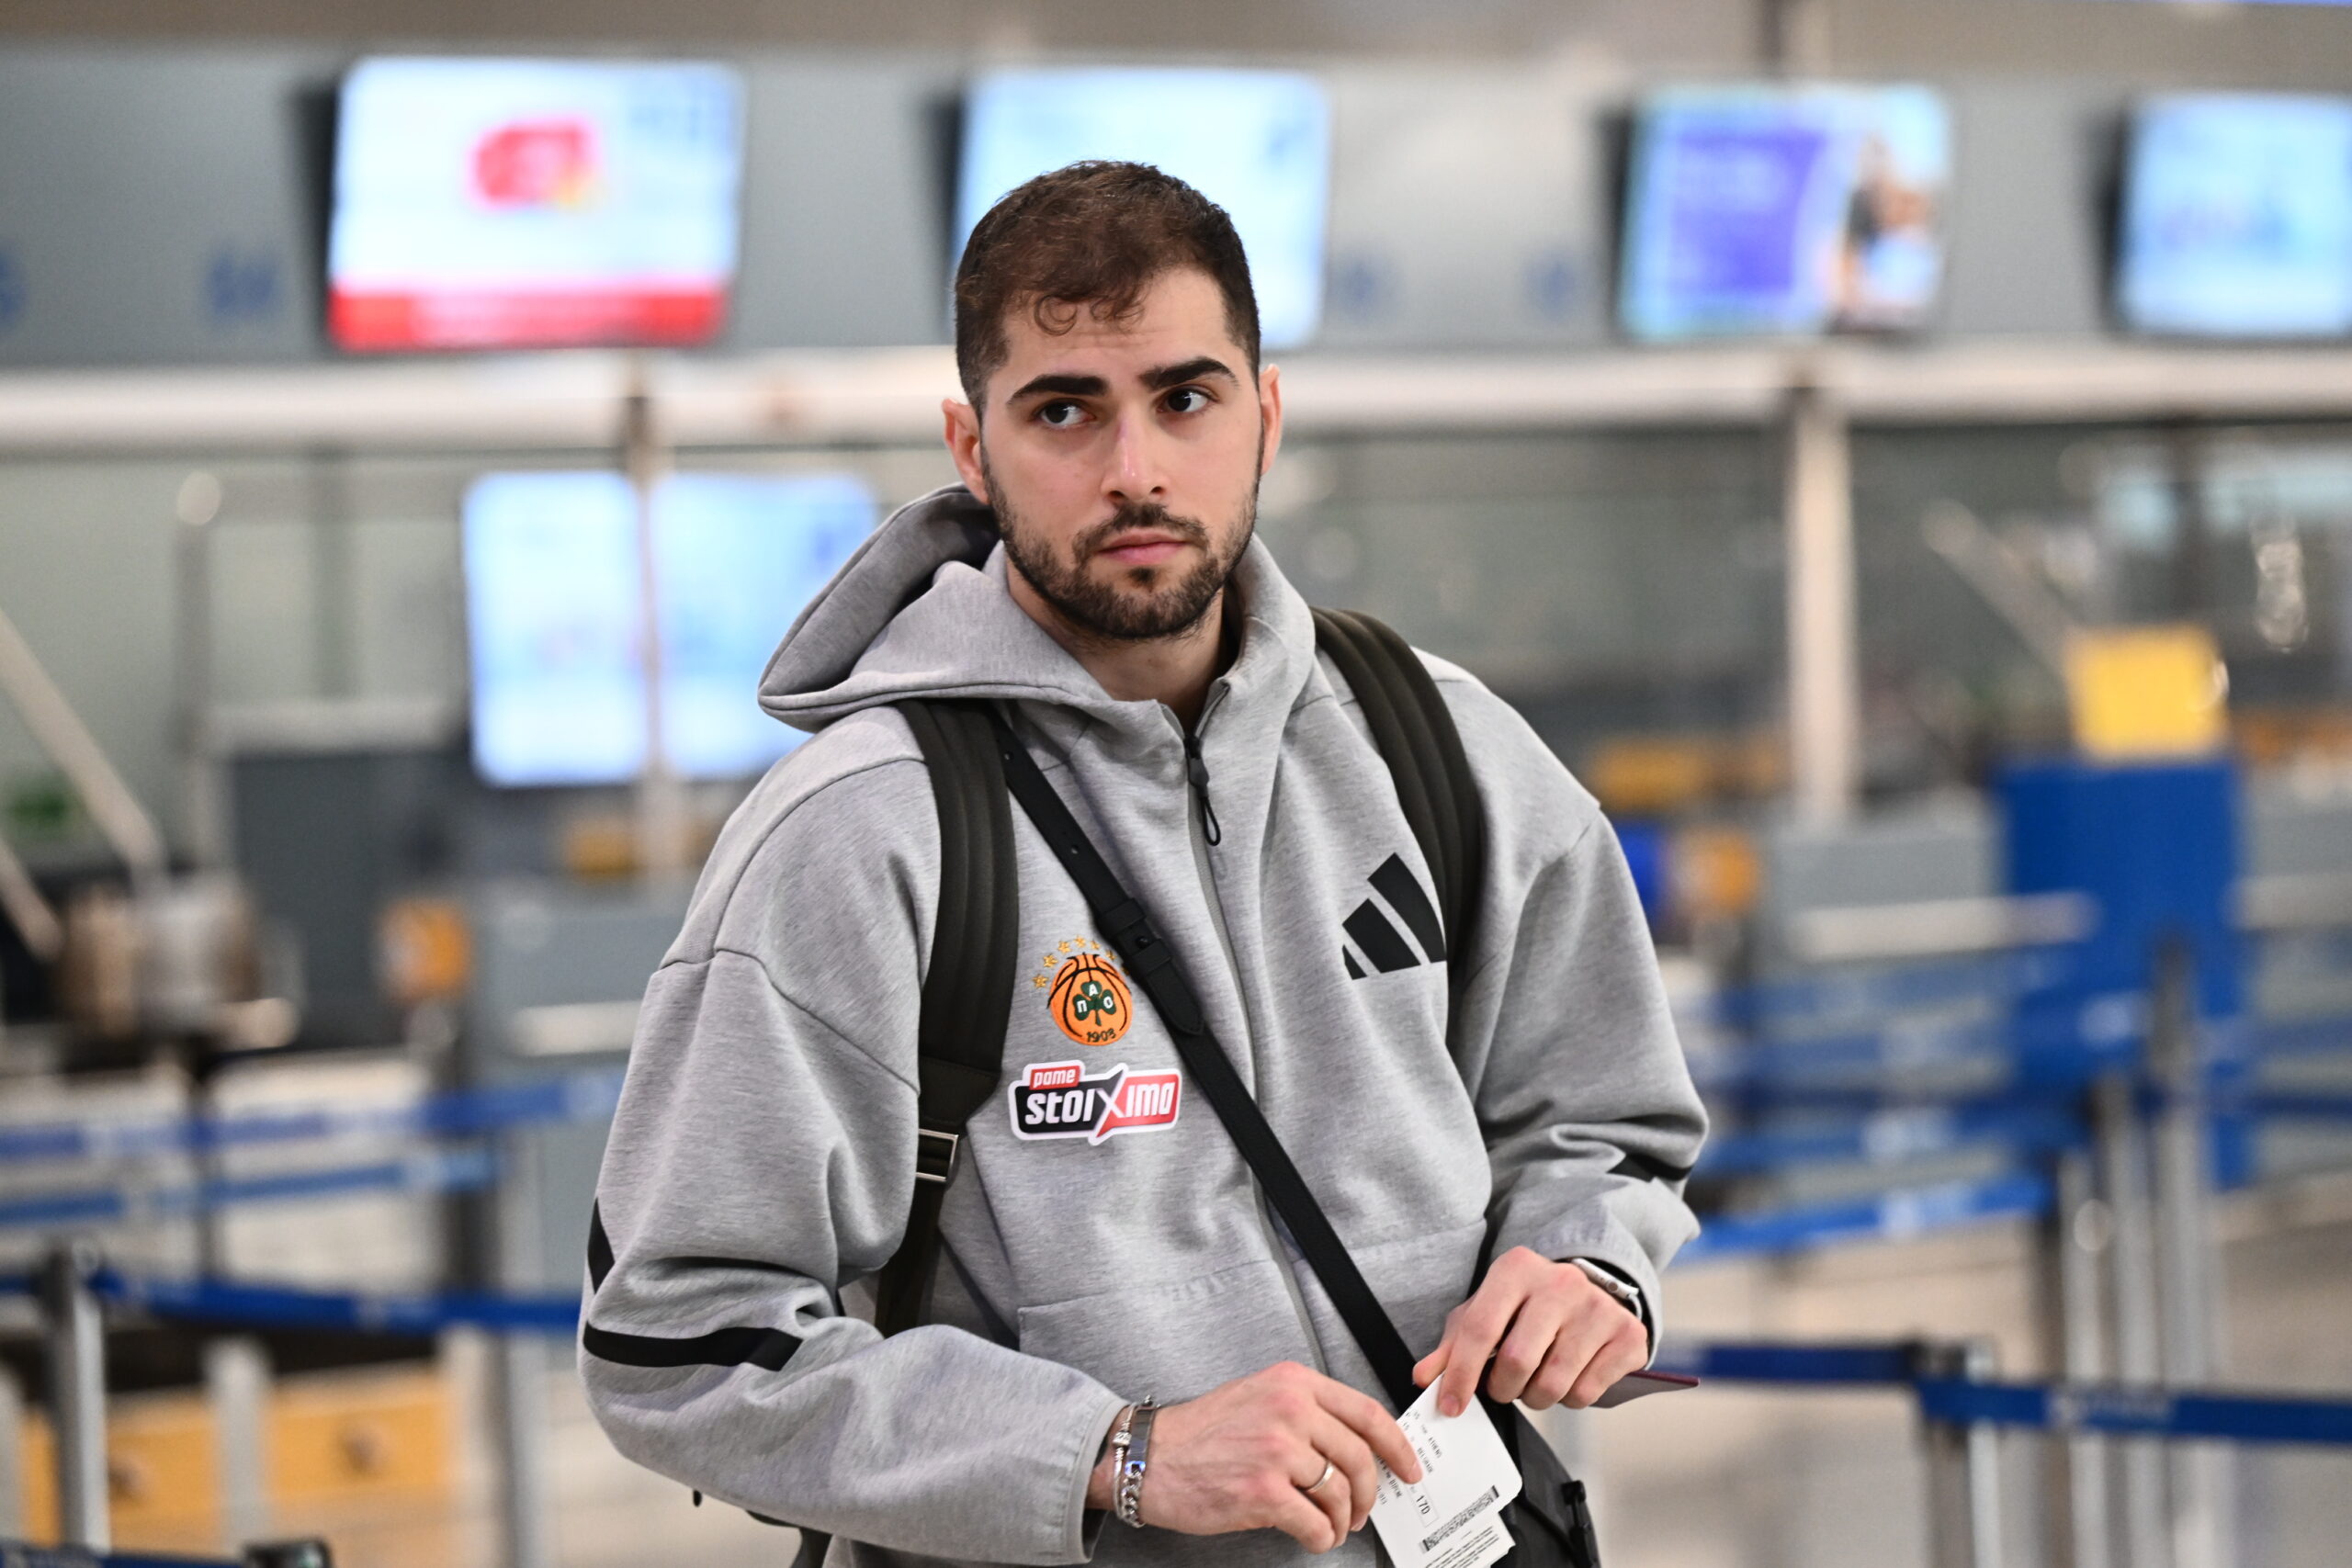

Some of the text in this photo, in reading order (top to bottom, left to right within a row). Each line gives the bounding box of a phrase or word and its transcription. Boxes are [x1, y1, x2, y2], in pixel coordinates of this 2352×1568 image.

[1086, 1029, 1117, 1043] 1903
[1033, 1068, 1076, 1088] pame
[1416, 1495, 1430, 1515] 17D
